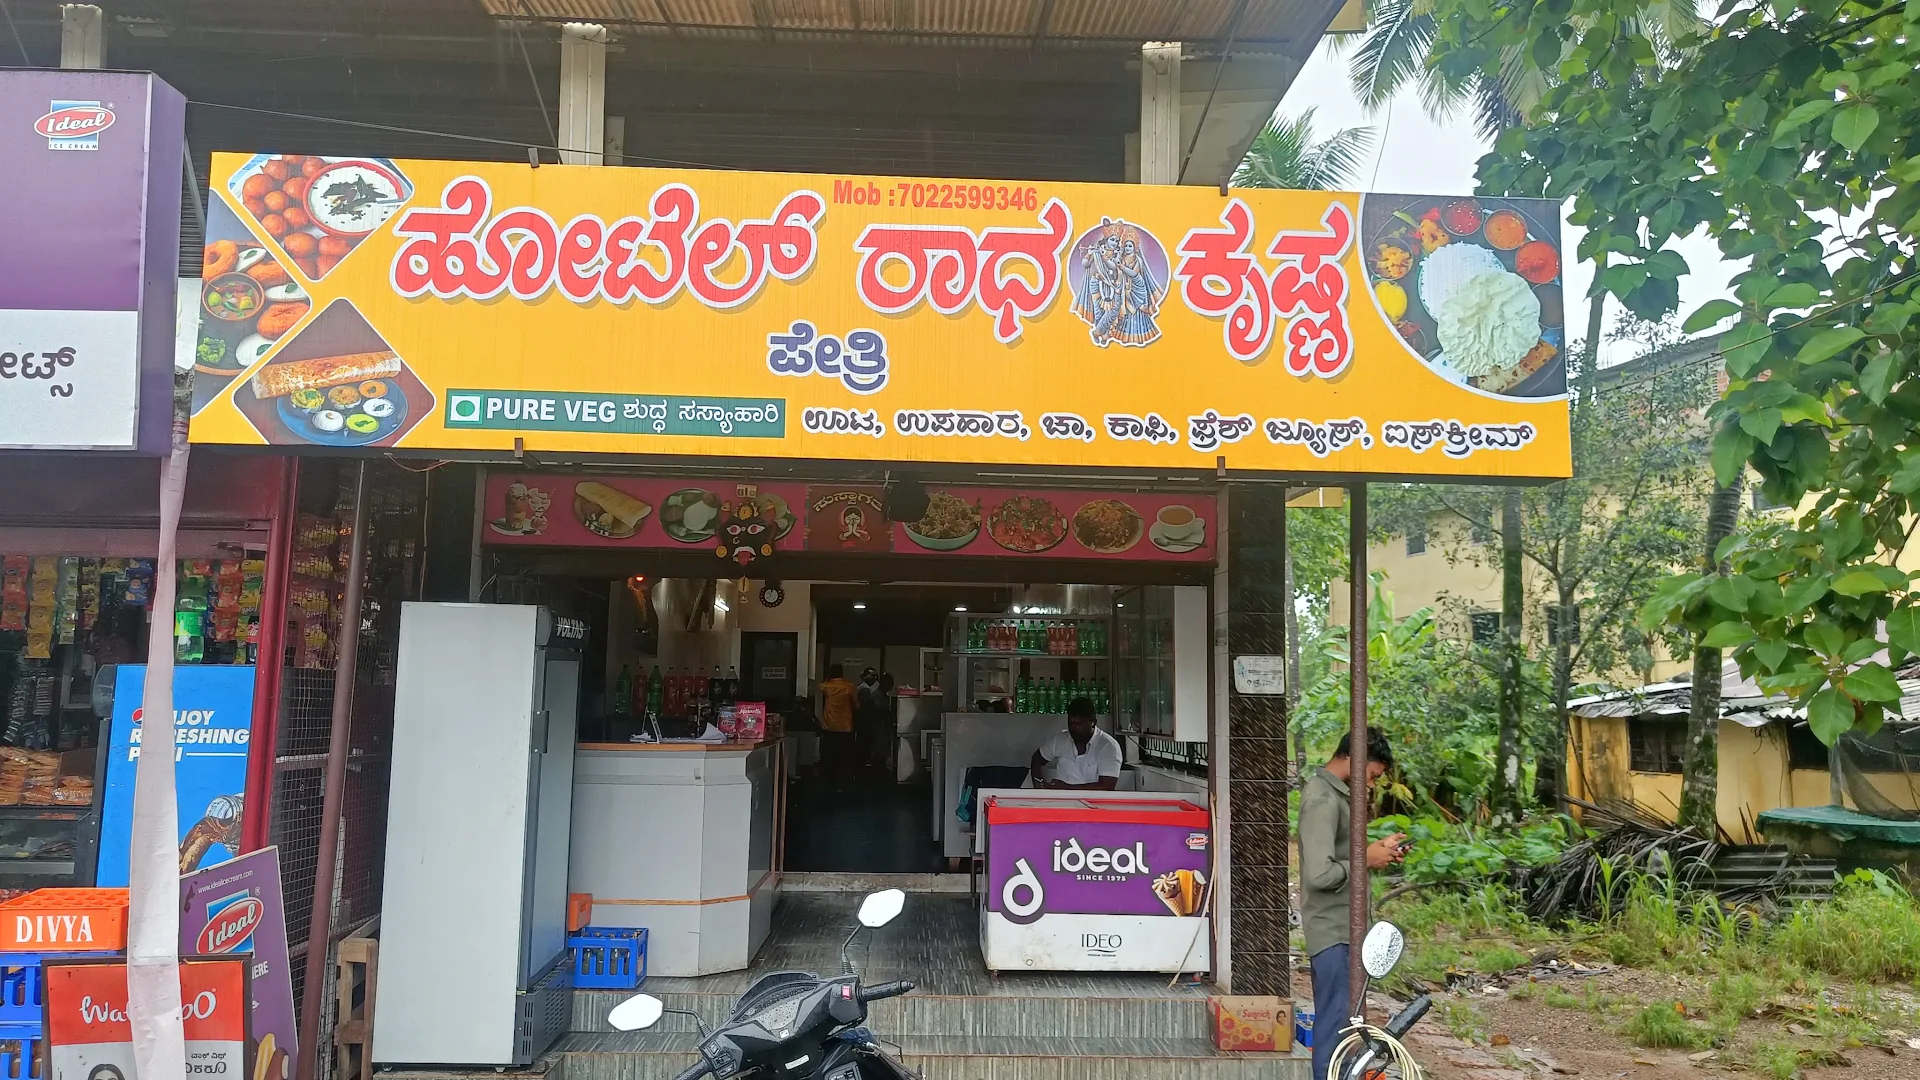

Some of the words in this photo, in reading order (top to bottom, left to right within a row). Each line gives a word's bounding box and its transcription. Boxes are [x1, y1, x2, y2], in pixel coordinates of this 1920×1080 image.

[46, 112, 106, 133] Ideal
[833, 179, 881, 206] Mob
[392, 178, 823, 305] ಹೋಟೆಲ್
[857, 202, 1070, 338] ರಾಧ
[1179, 202, 1352, 374] ಕೃಷ್ಣ
[769, 322, 886, 392] ಪೇತ್ರಿ
[486, 397, 556, 422] PURE
[563, 400, 616, 423] VEG
[623, 399, 668, 433] ಶುದ್ಧ
[679, 400, 779, 434] ಸಸ್ಯಾಹಾರಿ
[173, 710, 215, 726] JOY
[130, 728, 250, 745] RESHING
[1053, 837, 1149, 874] ideal
[16, 915, 94, 943] DIVYA
[208, 903, 256, 951] Ideal
[1081, 934, 1122, 949] IDEO
